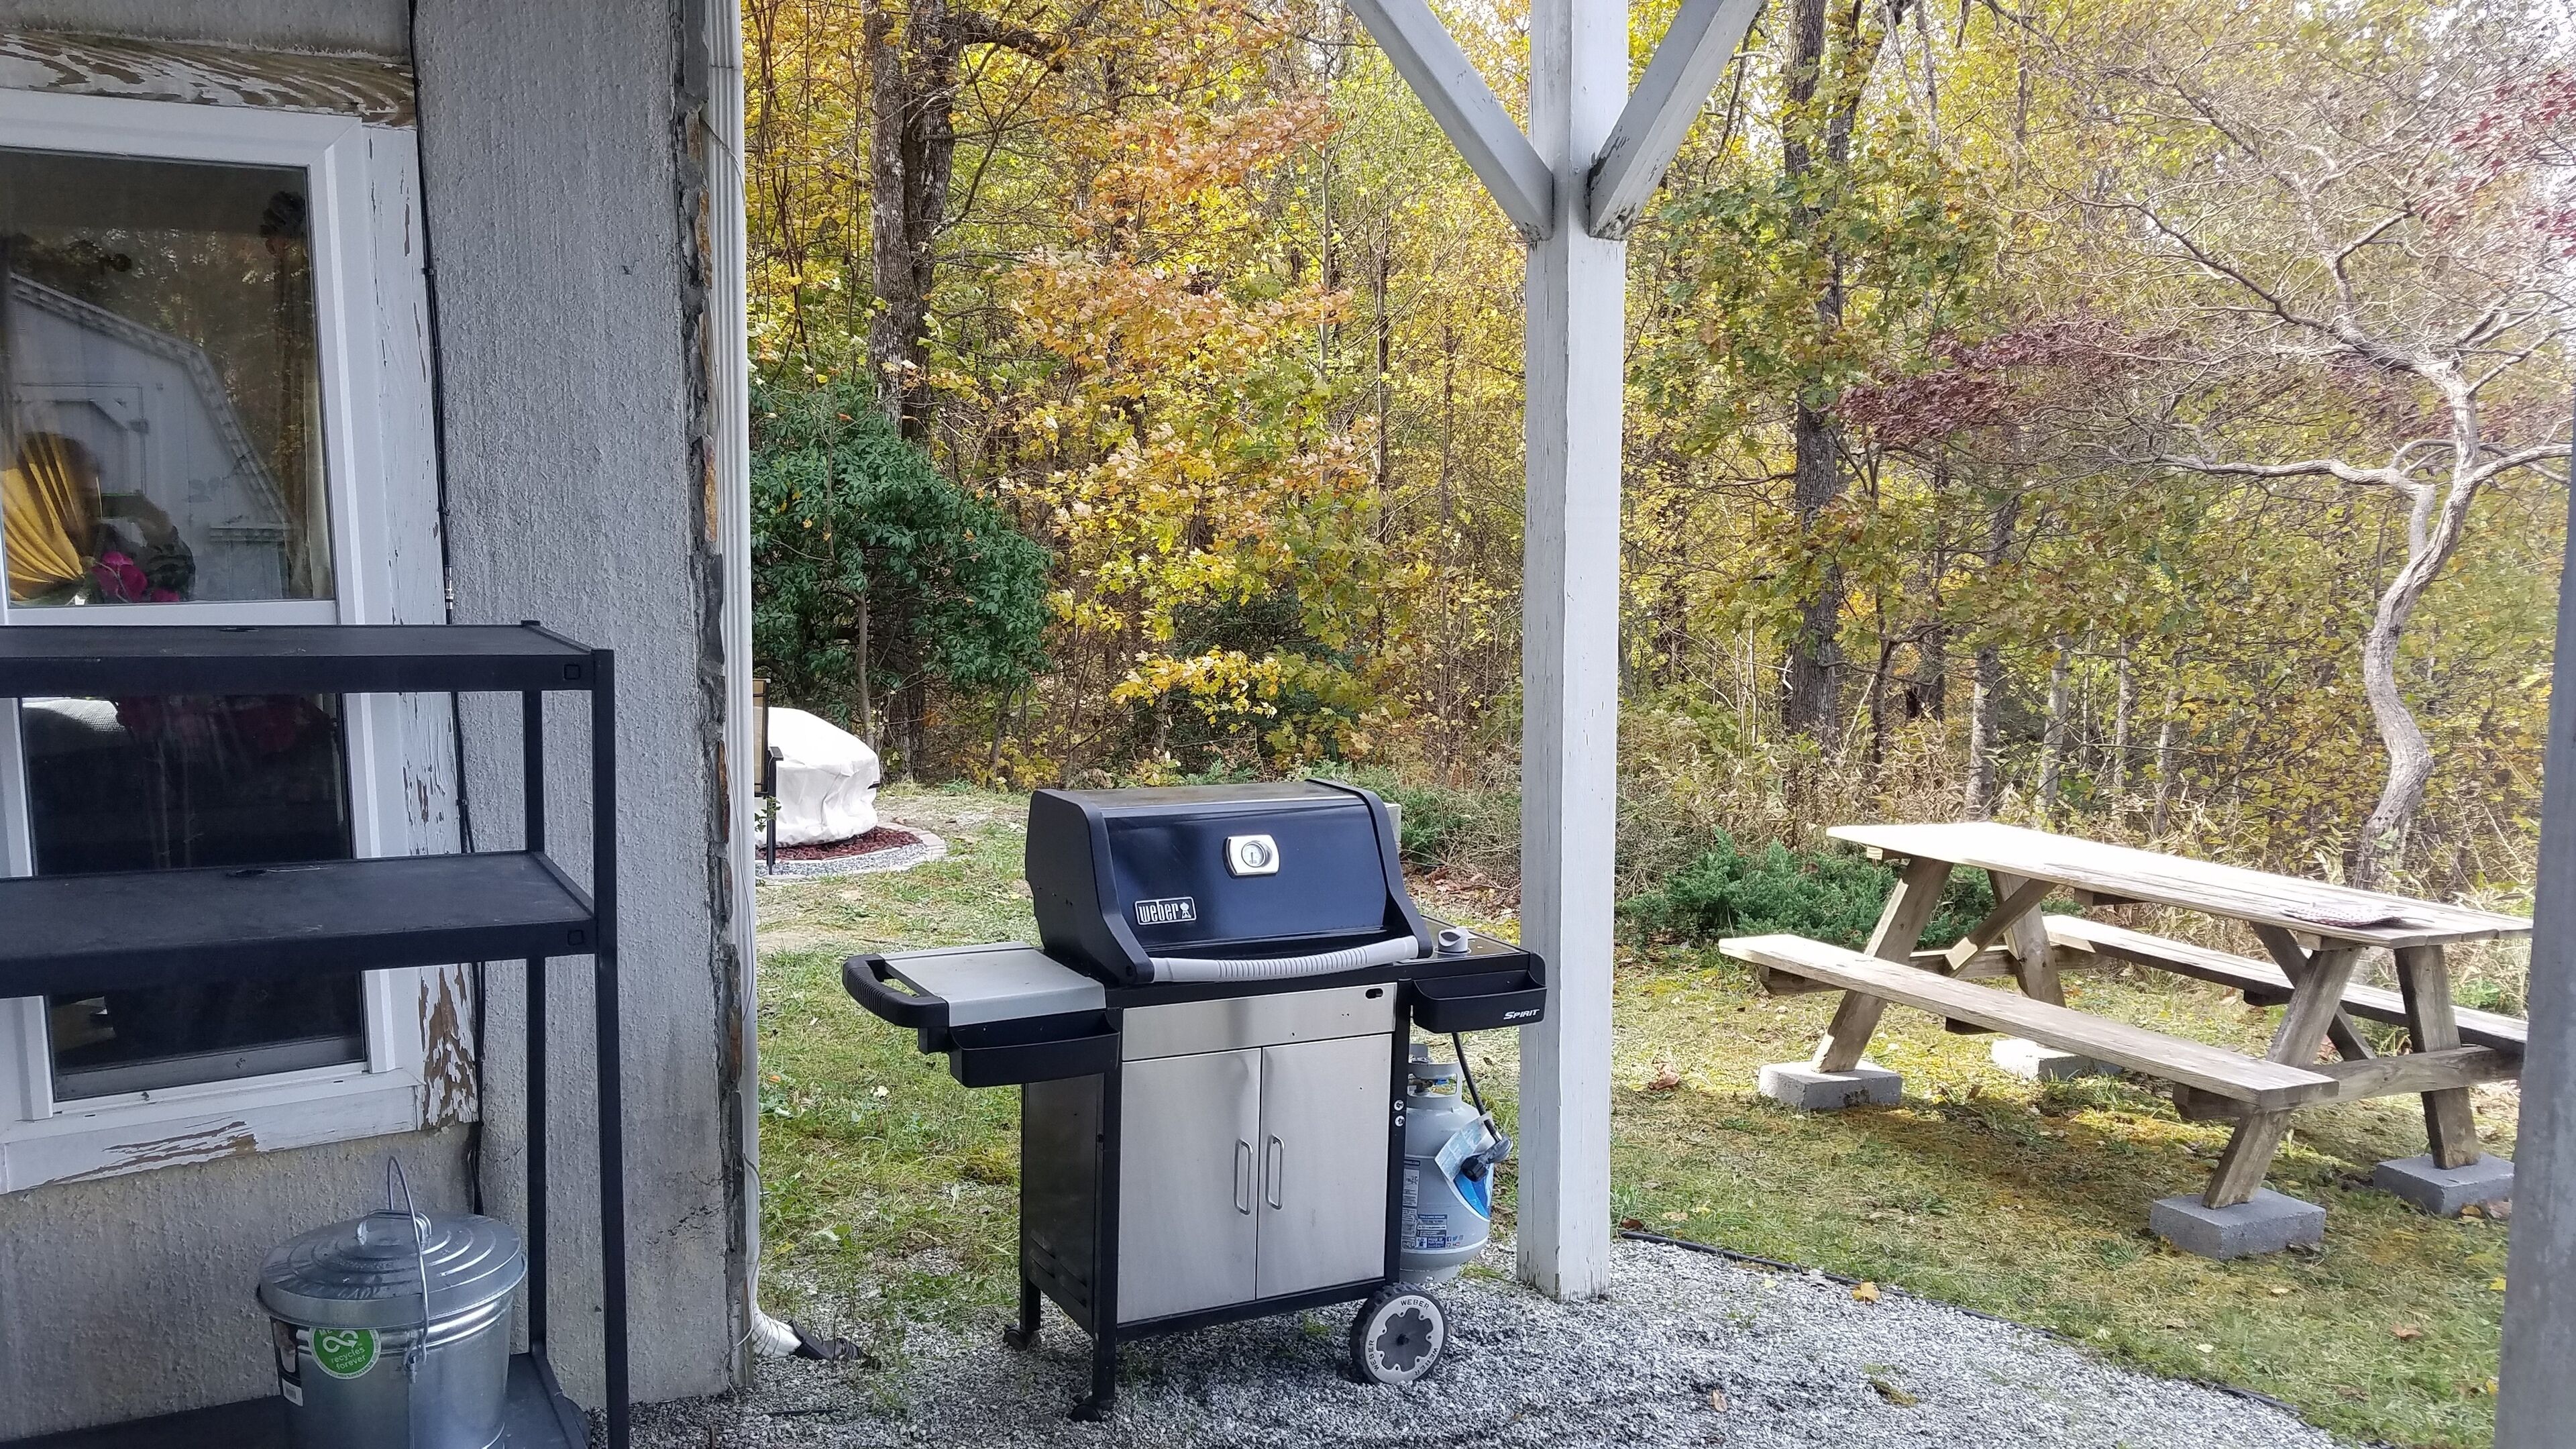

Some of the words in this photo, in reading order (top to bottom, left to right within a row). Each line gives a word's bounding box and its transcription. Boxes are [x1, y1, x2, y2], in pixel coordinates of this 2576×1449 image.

[1138, 900, 1179, 922] weber
[1503, 1009, 1540, 1020] SPIRIT
[1401, 1299, 1430, 1309] WEBER
[331, 1346, 366, 1364] recycles
[336, 1355, 366, 1370] forever
[1368, 1340, 1380, 1372] WEBER
